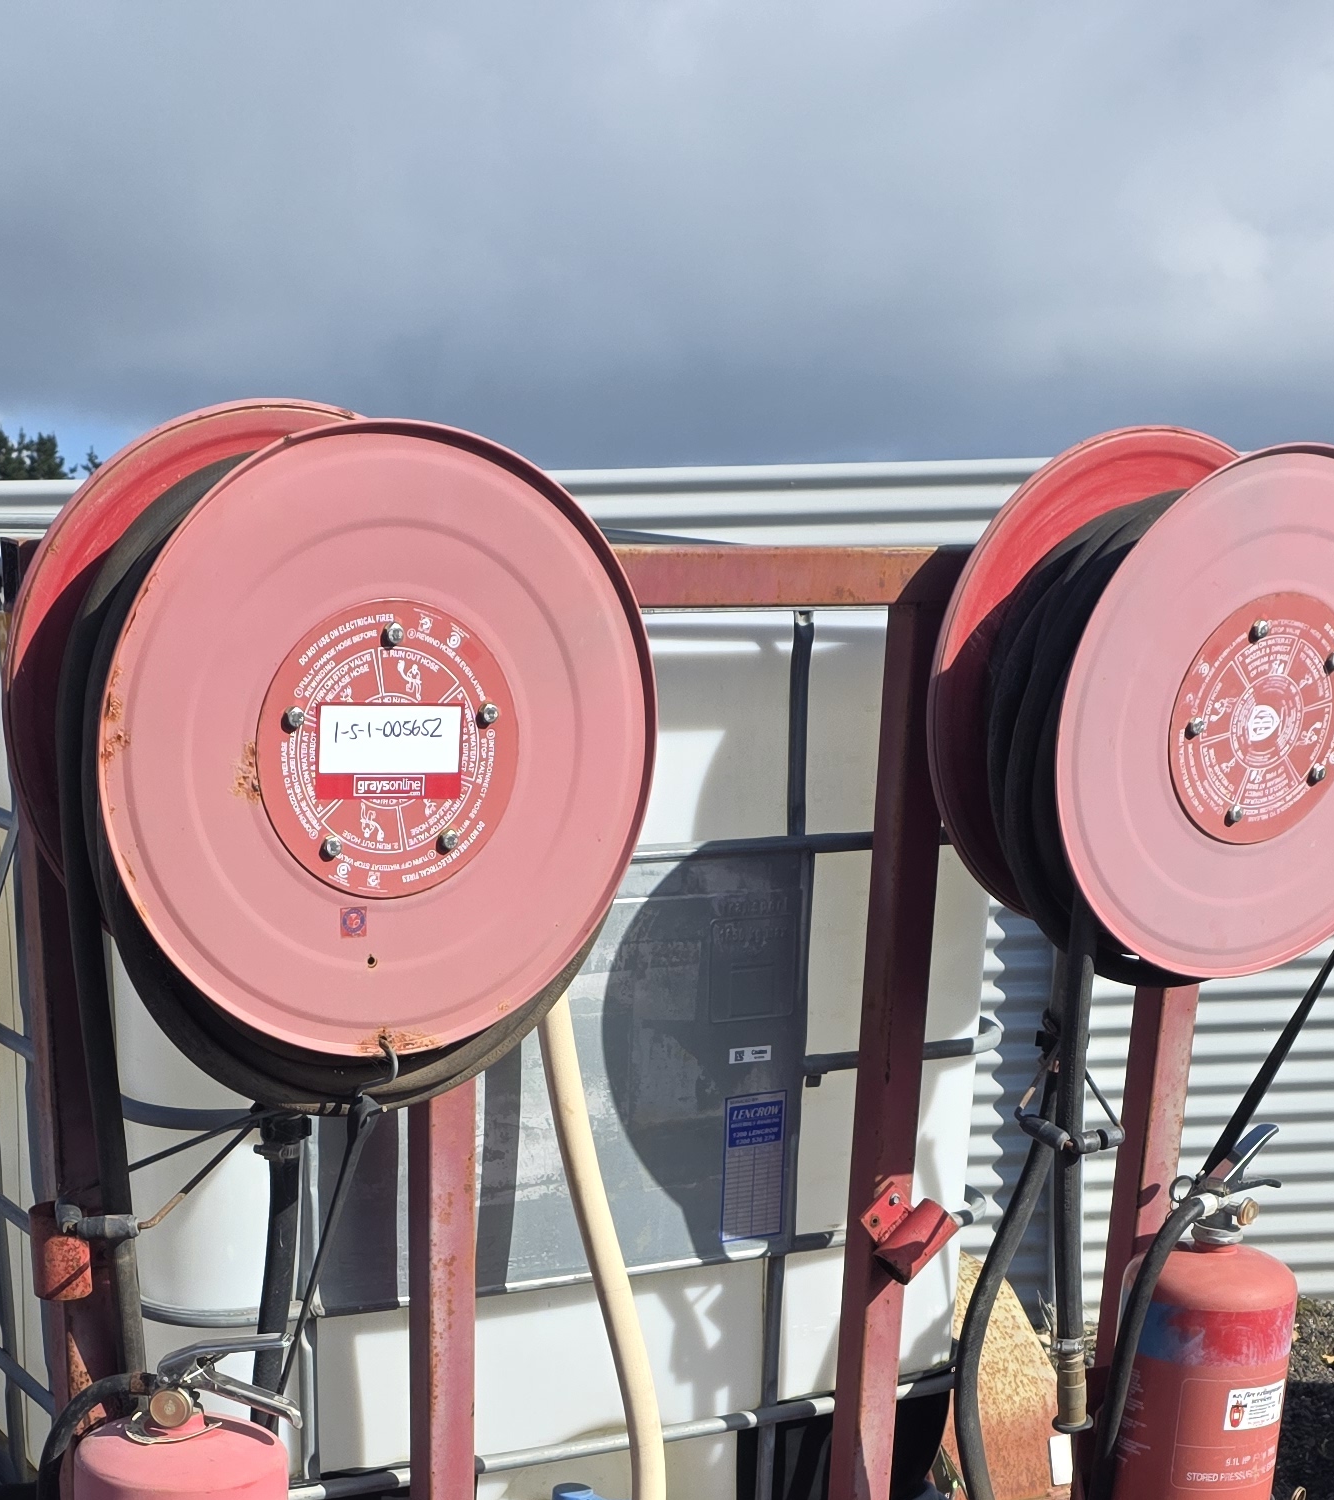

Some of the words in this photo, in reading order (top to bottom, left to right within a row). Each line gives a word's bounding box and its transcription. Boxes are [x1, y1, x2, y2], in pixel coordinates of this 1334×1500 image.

[299, 654, 309, 666] DO
[306, 643, 319, 658] NOT
[318, 636, 331, 650] USE
[329, 628, 339, 639] ON
[339, 614, 375, 634] ELECTRICAL
[375, 614, 394, 622] FIRES
[299, 668, 315, 688] FULLY
[313, 648, 337, 670] CHARGE
[336, 639, 352, 652] HOSE
[352, 630, 377, 643] BEFORE
[405, 652, 421, 664] OUT
[421, 658, 440, 672] HOSE
[415, 632, 441, 647] REWIND
[439, 643, 457, 660] HOSE
[455, 655, 461, 664] IN
[460, 660, 473, 678] EVEN
[470, 675, 486, 702] LAYERS
[304, 660, 335, 698] REWINDING
[324, 678, 334, 690] ON
[333, 664, 349, 680] STOP
[349, 654, 371, 667] VALVE
[325, 675, 351, 702] RELEASE
[351, 664, 369, 678] HOSE
[303, 730, 309, 740] AT
[309, 732, 317, 762] DIRECT
[469, 734, 477, 761] WATER
[281, 742, 289, 776] RELEASE
[301, 742, 309, 770] WATER
[461, 743, 469, 772] DIRECT
[289, 758, 297, 781] CLOSE
[303, 770, 312, 782] ON
[476, 760, 485, 784] VALVE
[479, 740, 495, 798] INTERCONNECT
[284, 777, 291, 790] TO
[293, 782, 303, 800] THEN
[357, 778, 421, 794] graysonline
[287, 790, 300, 815] NOZZLE
[469, 798, 482, 819] HOSE
[299, 800, 321, 830] PRESSURE
[429, 799, 452, 824] RELEASE
[446, 812, 453, 820] ON
[298, 814, 311, 832] OPEN
[410, 823, 429, 836] HOSE
[429, 818, 446, 834] STOP
[457, 820, 471, 837] WITH
[475, 820, 486, 832] DO
[342, 830, 361, 844] HOSE
[361, 840, 375, 848] OUT
[409, 834, 430, 846] VALVE
[467, 830, 479, 842] NOT
[377, 842, 391, 850] RUN
[459, 840, 469, 852] USE
[413, 854, 429, 866] TURN
[451, 850, 460, 860] ON
[353, 860, 371, 870] STOP
[379, 863, 400, 871] WATER
[401, 860, 413, 868] OFF
[419, 856, 453, 878] ELECTRICAL
[401, 872, 419, 882] FIRES
[733, 1104, 781, 1120] LENCROW
[749, 1126, 779, 1136] LENCROW
[1187, 1472, 1219, 1482] STORED
